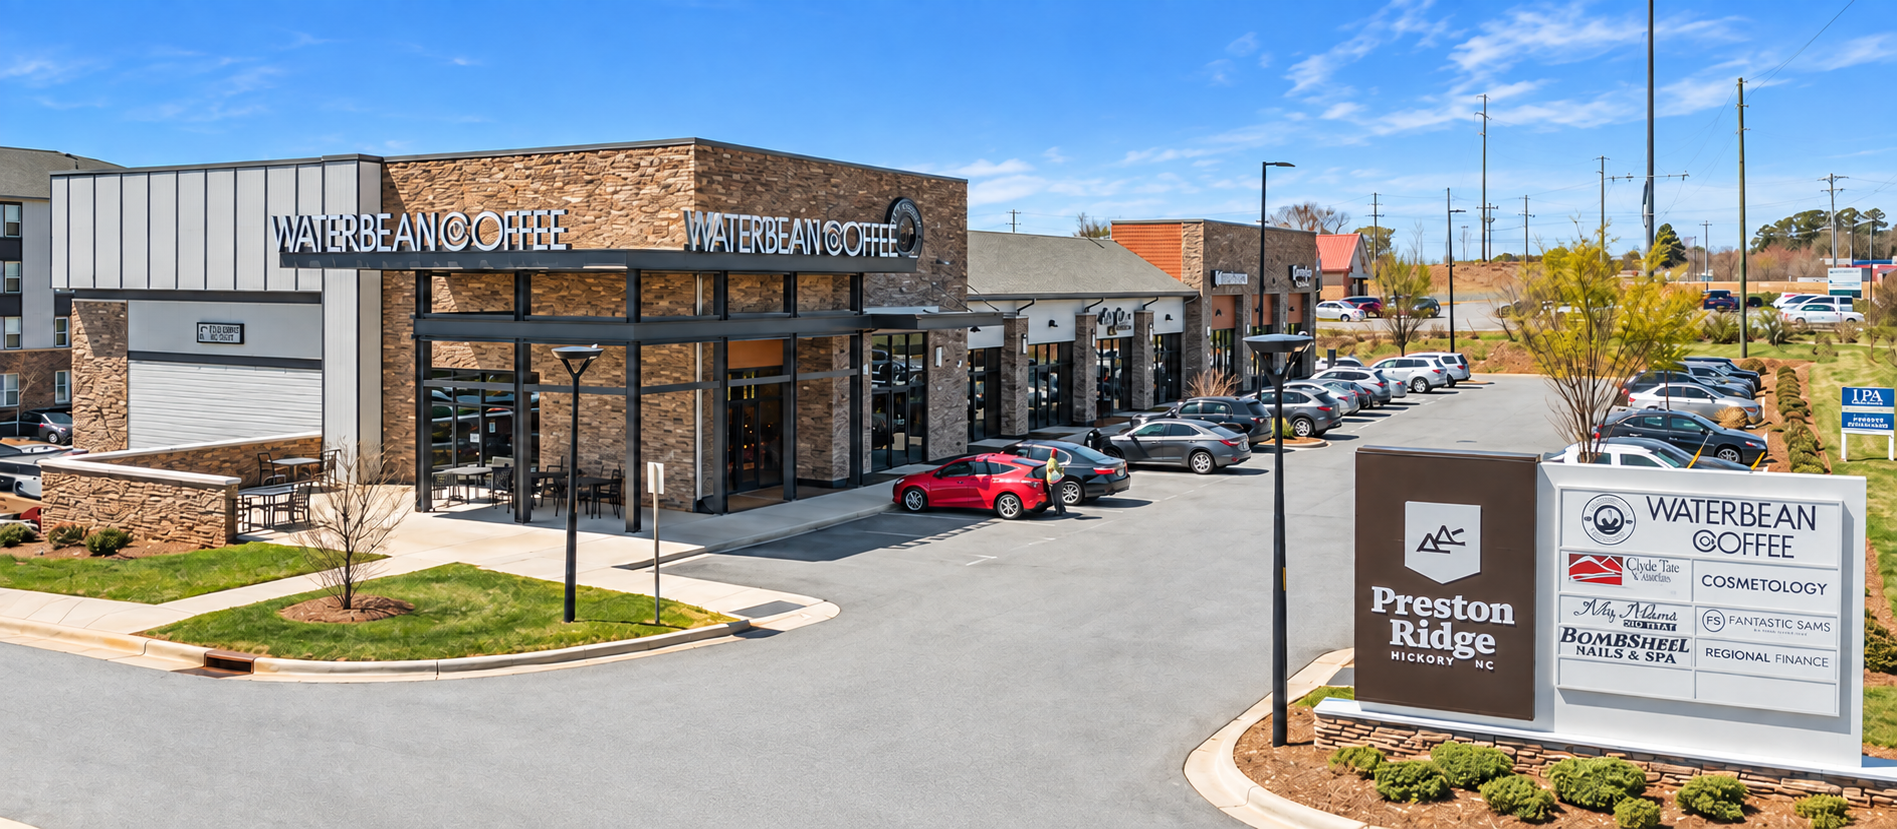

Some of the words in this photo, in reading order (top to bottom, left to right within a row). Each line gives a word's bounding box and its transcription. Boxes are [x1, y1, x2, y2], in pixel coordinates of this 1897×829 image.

[271, 211, 439, 253] WATERBEAN
[440, 209, 570, 251] COFFEE
[684, 209, 821, 255] WATERBEAN
[823, 219, 899, 257] COFFEE
[1646, 496, 1816, 531] WATERBEAN
[1693, 529, 1795, 559] COFFEE
[1626, 557, 1657, 574] Clyde
[1659, 559, 1680, 573] Tate
[1702, 574, 1828, 596] COSMETOLOGY
[1371, 586, 1515, 625] Preston
[1706, 615, 1721, 626] FS
[1729, 615, 1793, 630] FANTASTIC
[1797, 620, 1831, 633] SAMS
[1389, 619, 1496, 660] Ridge
[1391, 651, 1455, 666] HICKORY
[1475, 659, 1494, 670] NC
[1576, 645, 1623, 659] NAILS
[1628, 650, 1640, 661] &
[1645, 652, 1677, 664] SPA
[1705, 647, 1770, 663] REGIONAL
[1775, 654, 1829, 668] FINANCE
